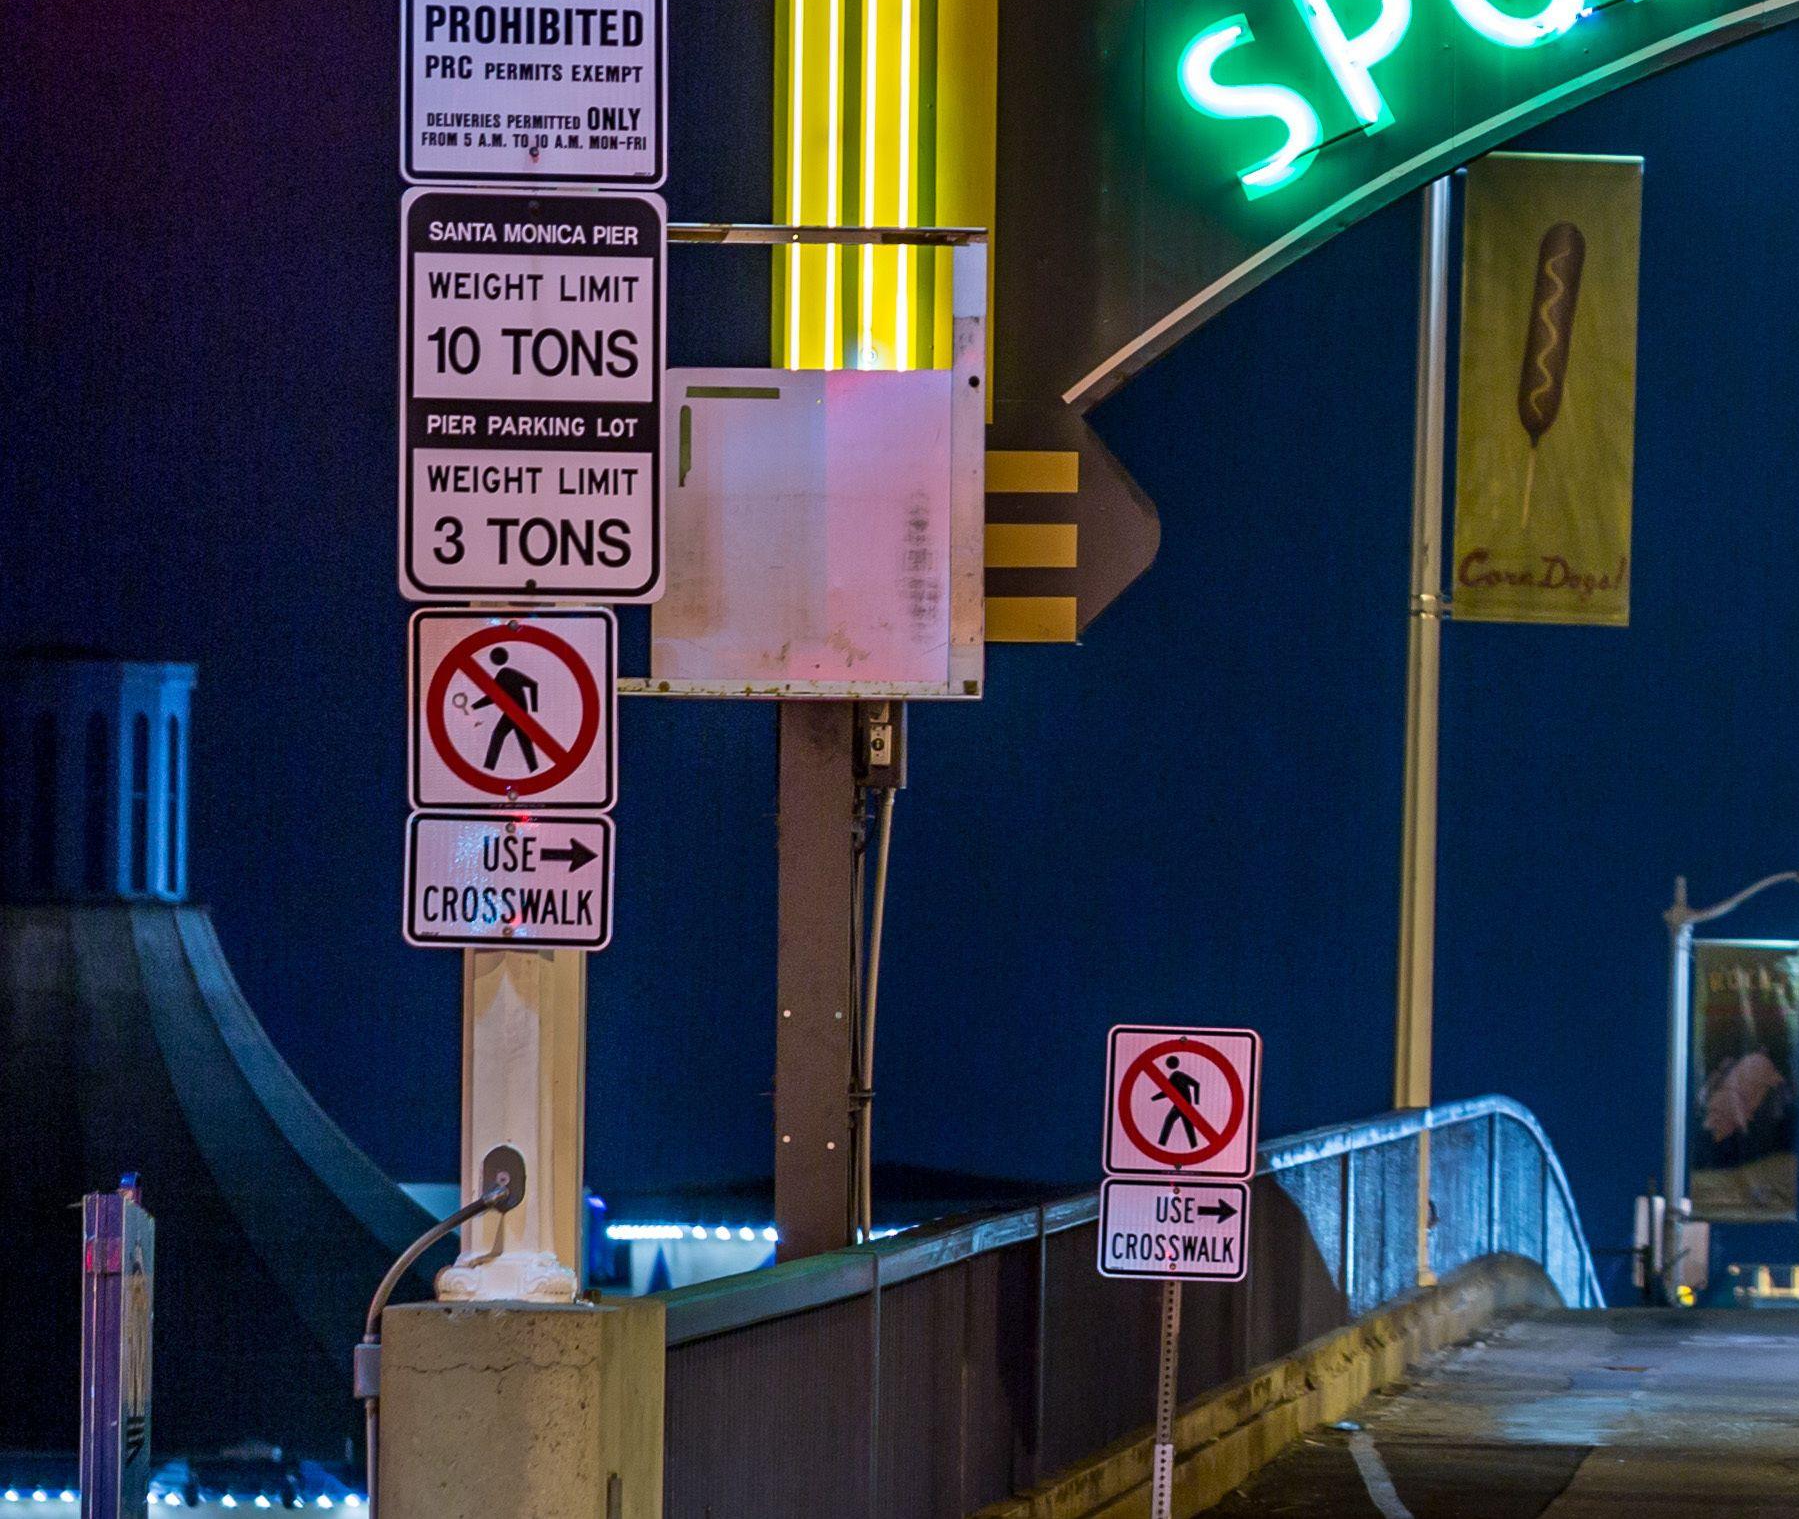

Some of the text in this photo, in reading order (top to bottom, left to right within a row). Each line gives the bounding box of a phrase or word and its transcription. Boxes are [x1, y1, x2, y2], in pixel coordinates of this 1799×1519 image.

[425, 5, 643, 46] PROHIBITED
[425, 55, 643, 83] PRC PERMITS EXEMPT
[427, 107, 641, 131] DELIVERIES PERMITTED ONLY
[421, 132, 646, 150] FROM 5 A.M. TO 10 A.M. MON-FRI
[429, 222, 638, 245] SANTA MONICA PIER
[429, 272, 639, 302] WEIGHT LIMIT
[428, 326, 639, 378] 10 TONS
[427, 415, 638, 437] PIER PARKING LOT
[428, 465, 638, 495] WEIGHT LIMIT
[433, 516, 632, 568] 3 TONS
[483, 836, 536, 872] USE
[423, 885, 593, 925] CROSSWALK
[1156, 1197, 1195, 1223] USE
[1112, 1233, 1234, 1263] CROSSWALK
